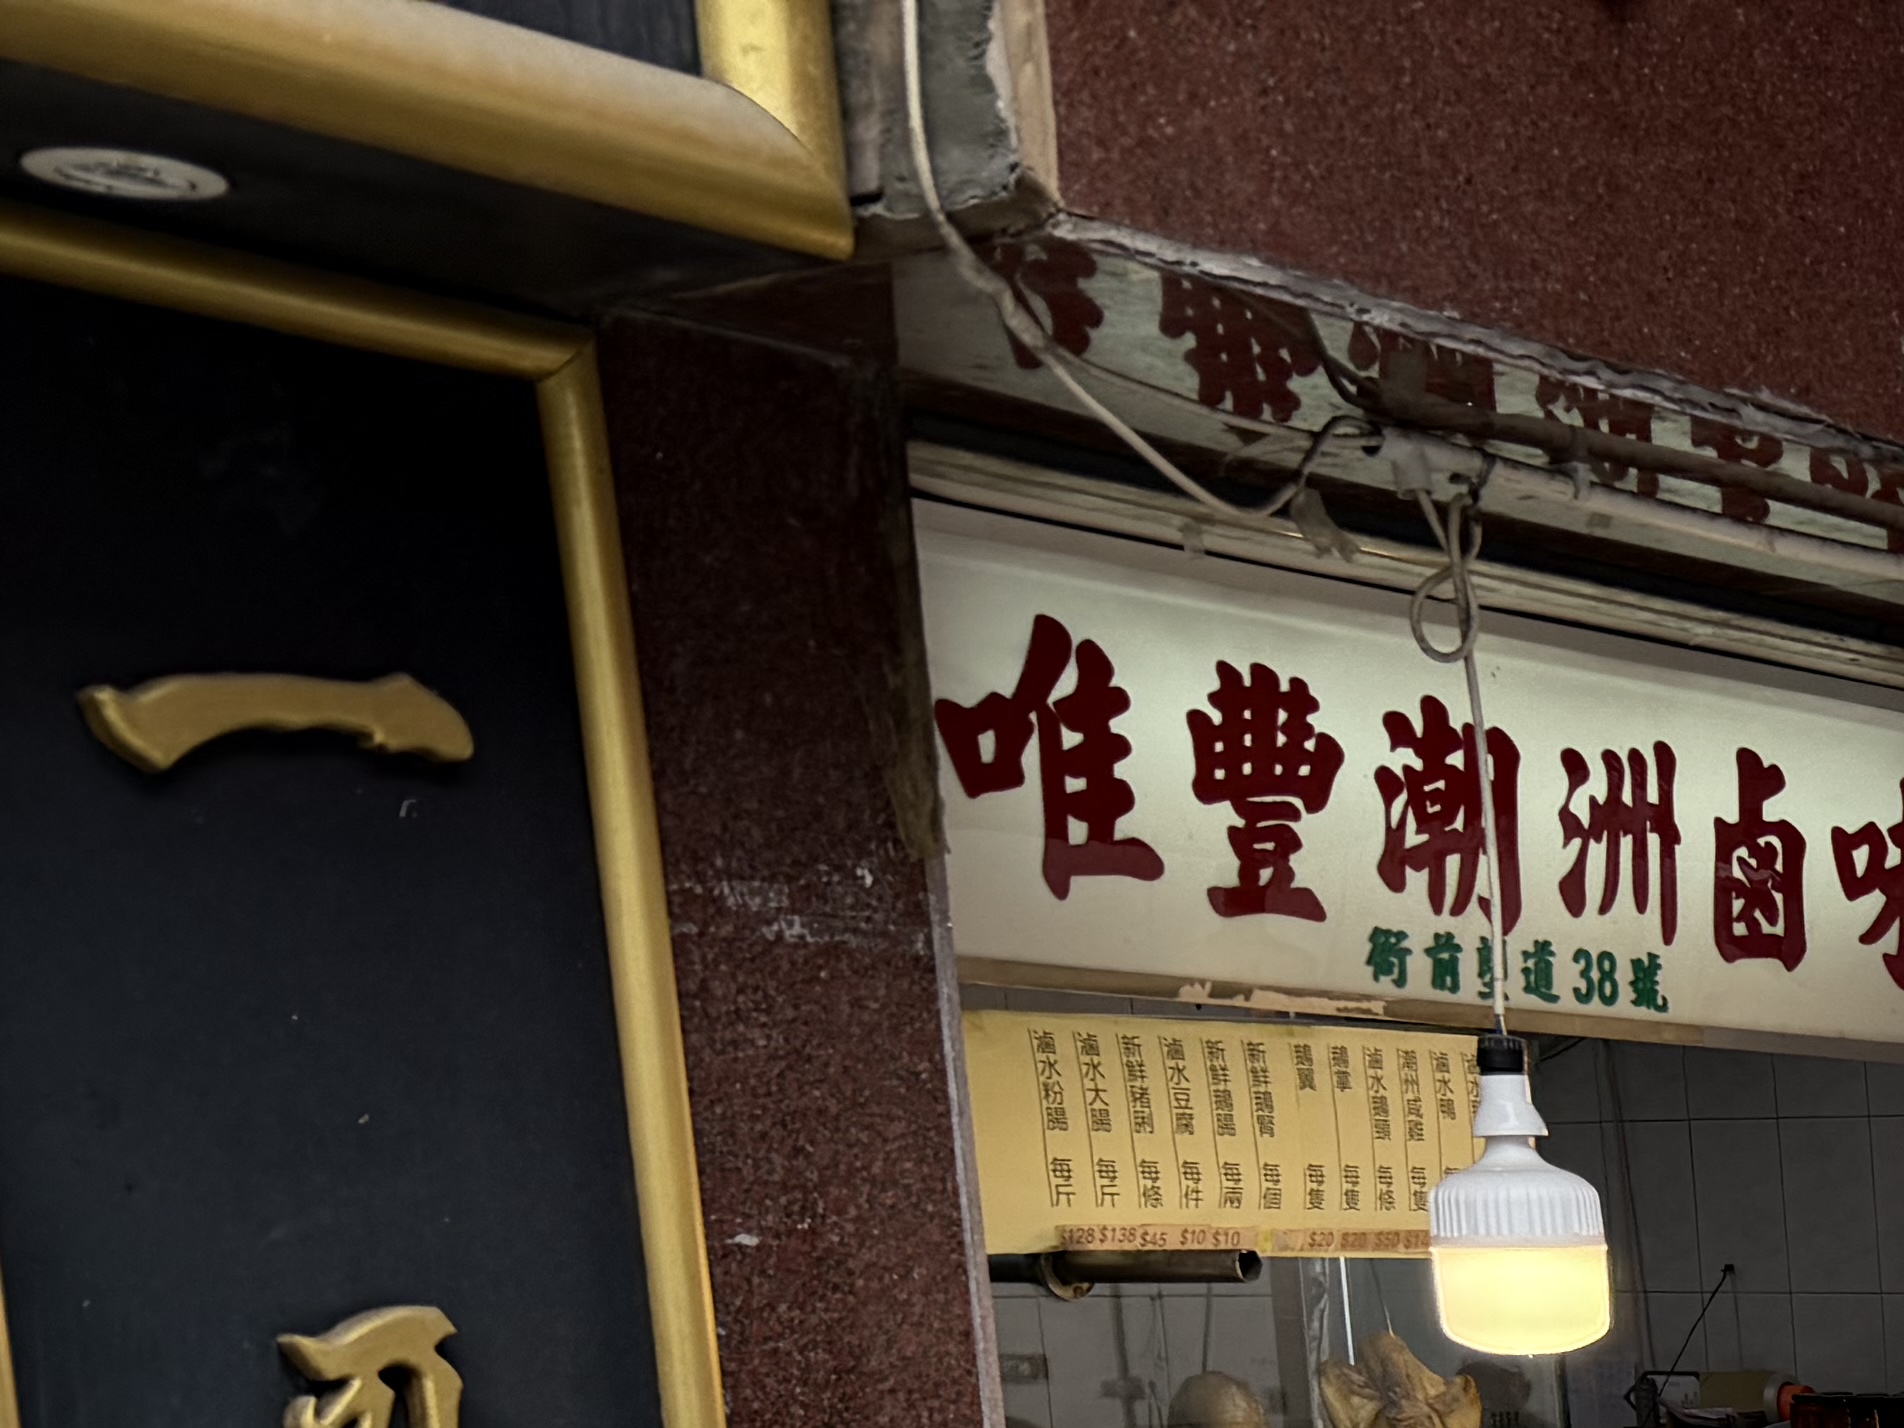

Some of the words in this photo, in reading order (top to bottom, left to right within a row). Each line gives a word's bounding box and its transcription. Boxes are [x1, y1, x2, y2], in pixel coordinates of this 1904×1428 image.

[1050, 1157, 1076, 1209] 每斤
[1096, 1158, 1121, 1209] 每斤
[1099, 1226, 1137, 1244] $138
[1139, 1230, 1168, 1248] $45
[1180, 1228, 1206, 1246] $10
[1212, 1230, 1241, 1247] $10
